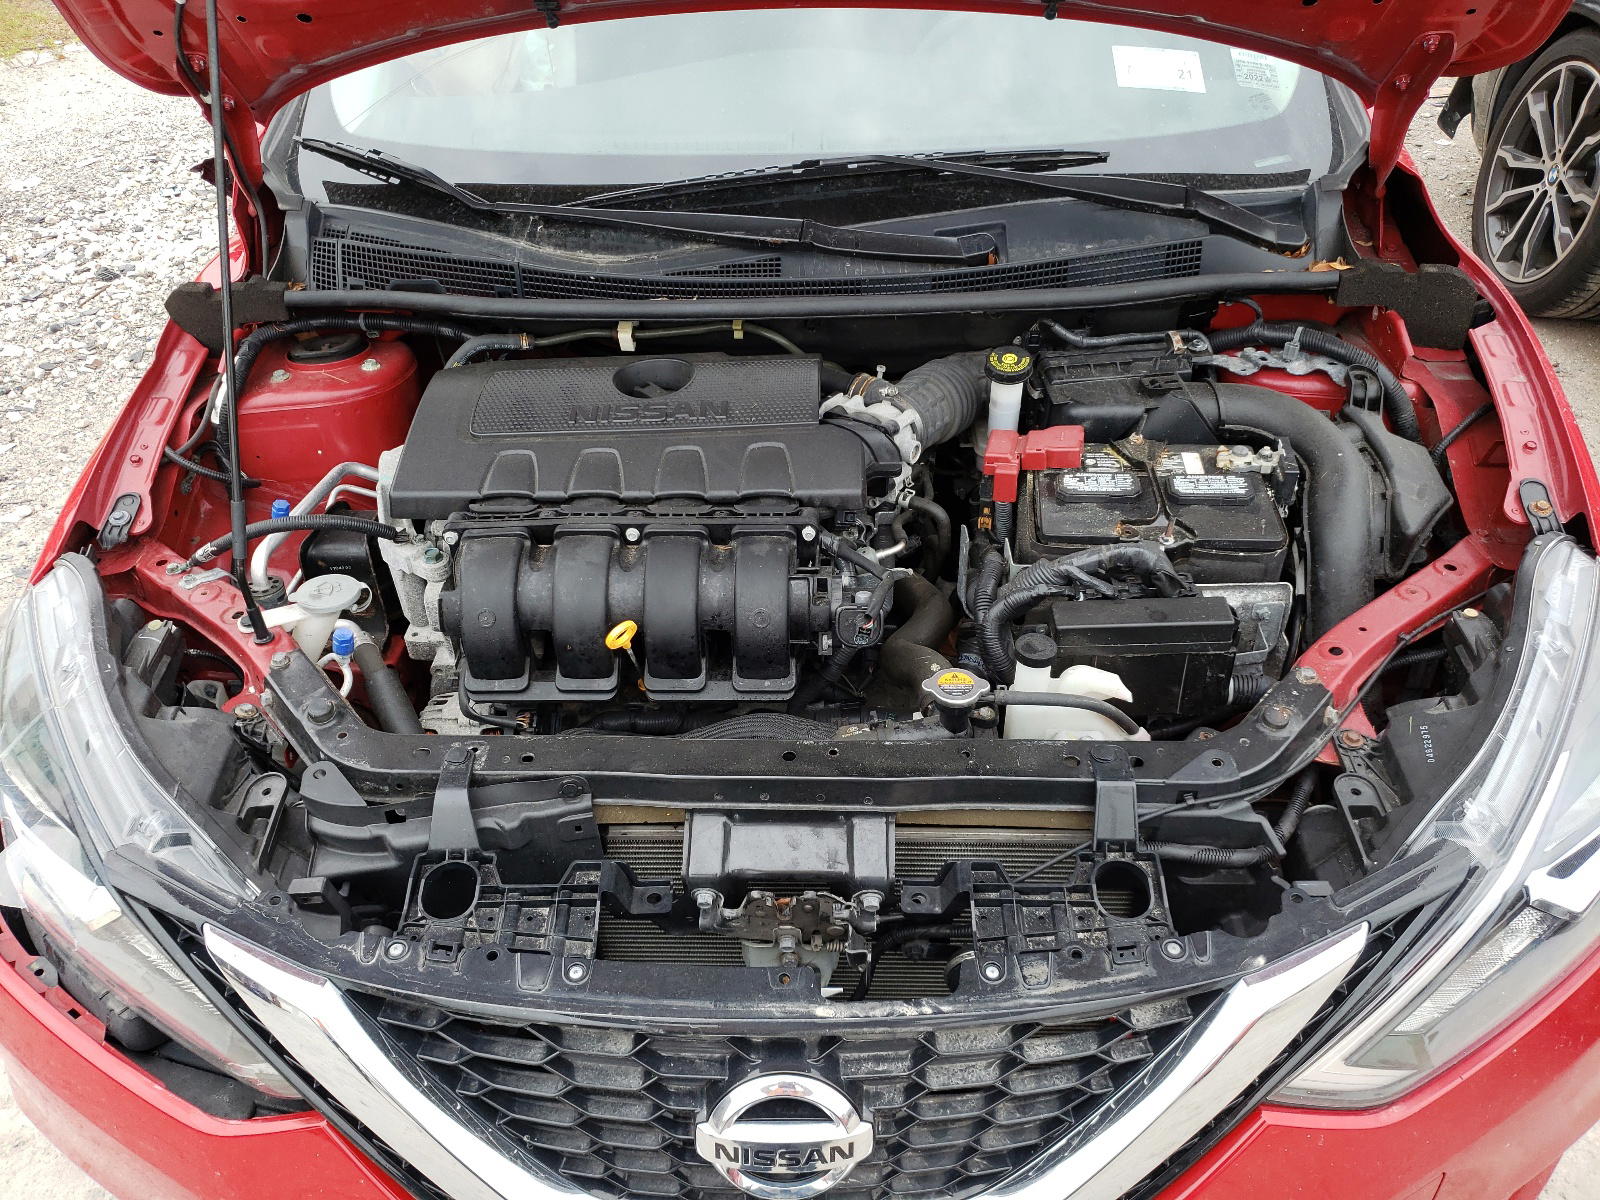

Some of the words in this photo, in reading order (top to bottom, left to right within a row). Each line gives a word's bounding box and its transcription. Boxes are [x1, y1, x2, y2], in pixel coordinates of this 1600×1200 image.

[1243, 72, 1264, 83] 2022
[568, 400, 729, 424] NISSAN
[714, 1141, 855, 1168] NISSAN
